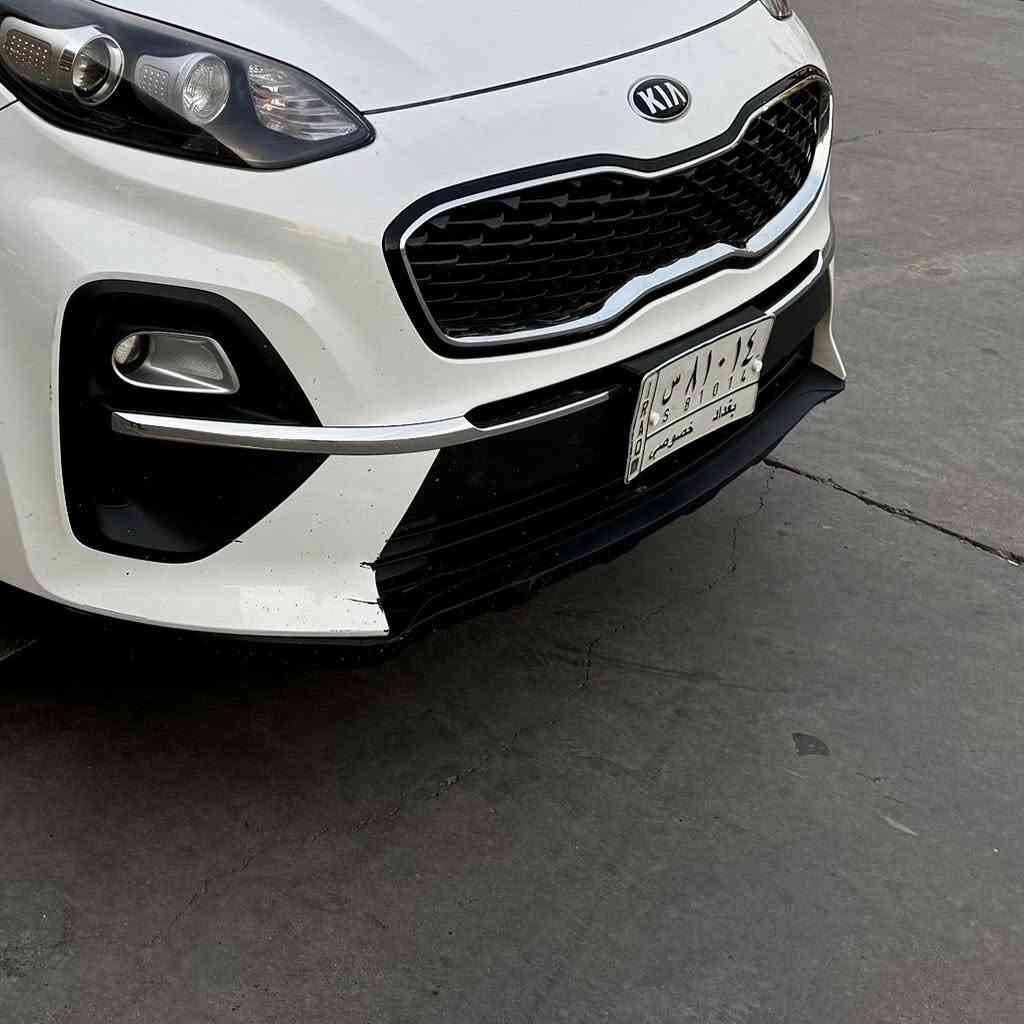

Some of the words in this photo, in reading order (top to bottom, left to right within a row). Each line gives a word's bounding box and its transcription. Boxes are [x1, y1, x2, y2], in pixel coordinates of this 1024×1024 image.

[636, 81, 688, 114] KIA
[712, 398, 737, 422] بغداد
[648, 421, 694, 460] خصوصي
